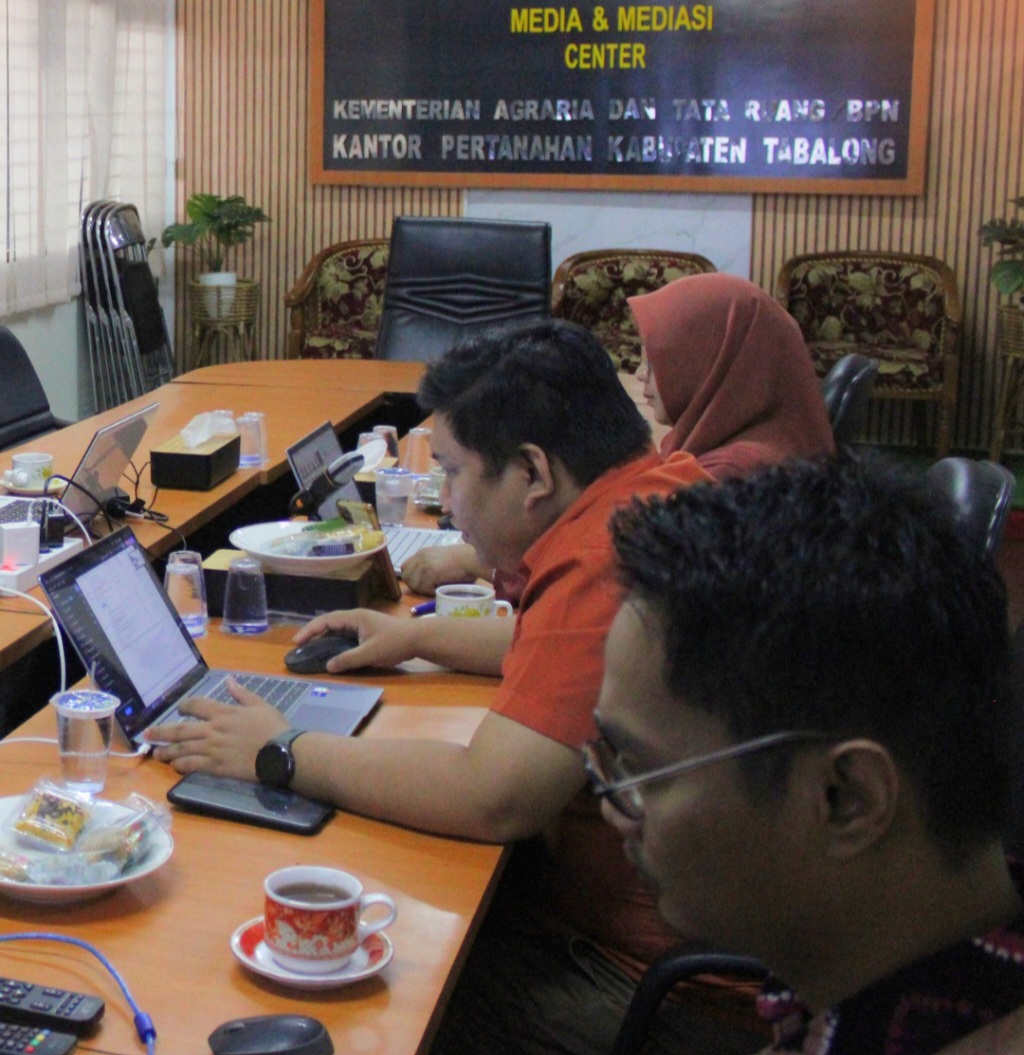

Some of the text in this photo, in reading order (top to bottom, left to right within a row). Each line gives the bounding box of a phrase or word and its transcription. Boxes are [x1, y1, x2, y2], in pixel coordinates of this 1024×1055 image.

[510, 4, 714, 33] MEDIA & MEDIASI
[564, 43, 646, 69] CENTER
[333, 99, 480, 120] KEMENTERIAN
[493, 99, 595, 121] AGRARIA
[608, 98, 656, 120] DAN
[672, 98, 730, 121] TATA
[332, 133, 422, 160] KANTOR
[441, 134, 593, 161] PERTANAHAN
[763, 136, 896, 165] TABALONG
